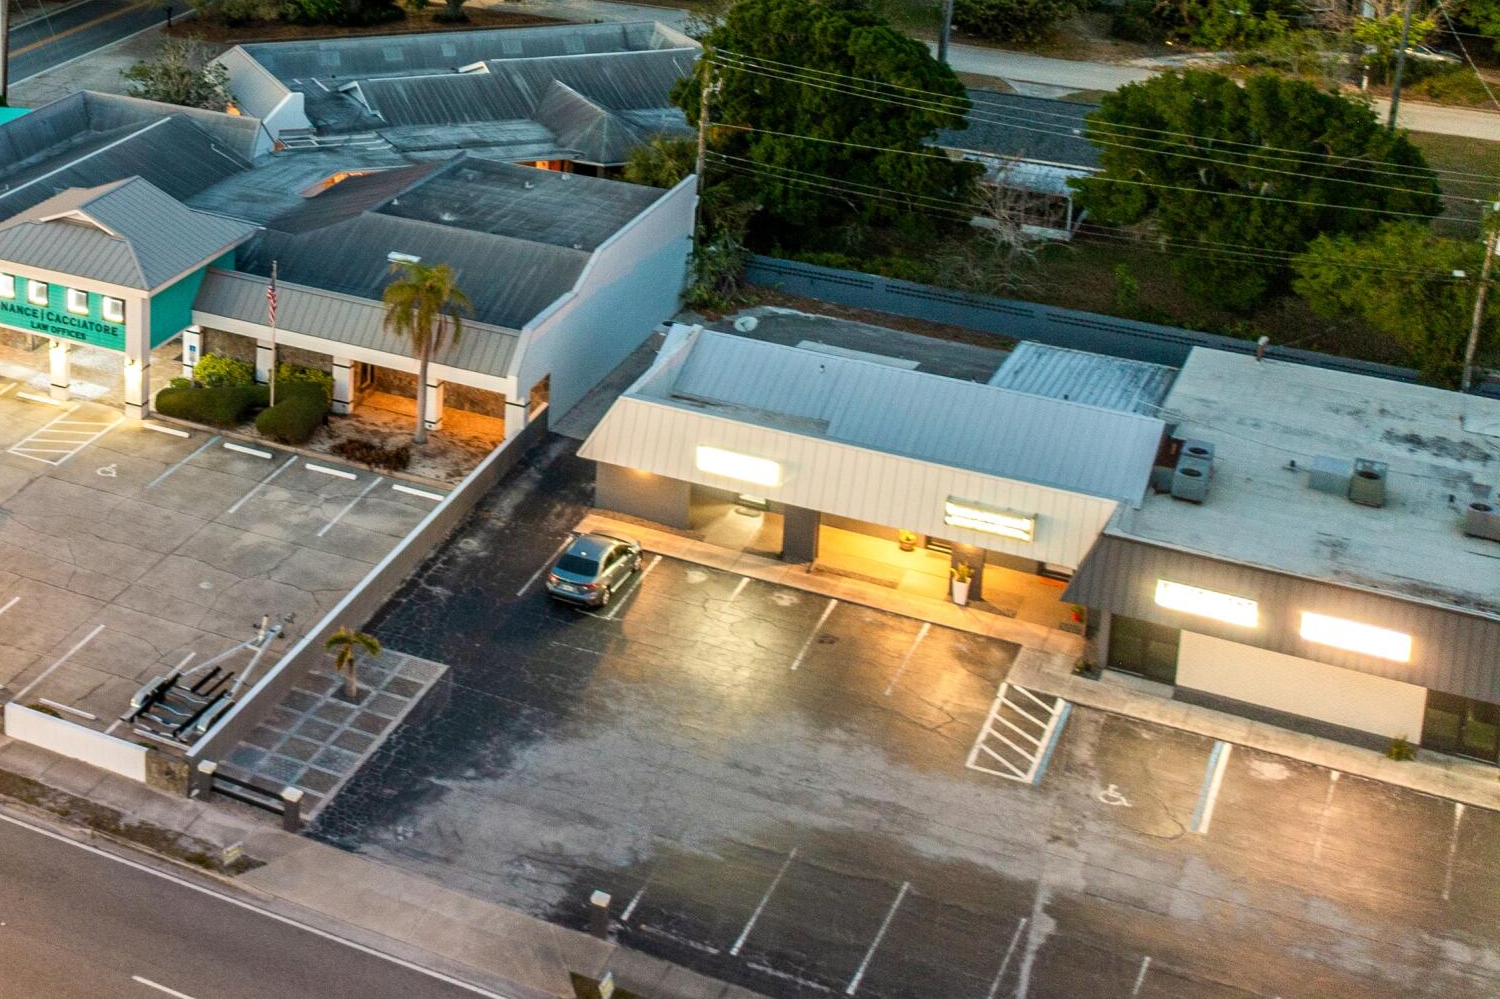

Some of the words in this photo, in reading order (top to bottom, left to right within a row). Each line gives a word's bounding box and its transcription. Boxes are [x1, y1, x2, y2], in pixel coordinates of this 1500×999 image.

[0, 301, 39, 319] NANCE
[46, 311, 119, 336] CACCIATORE
[30, 320, 49, 331] LAW
[51, 325, 87, 340] OFFICES
